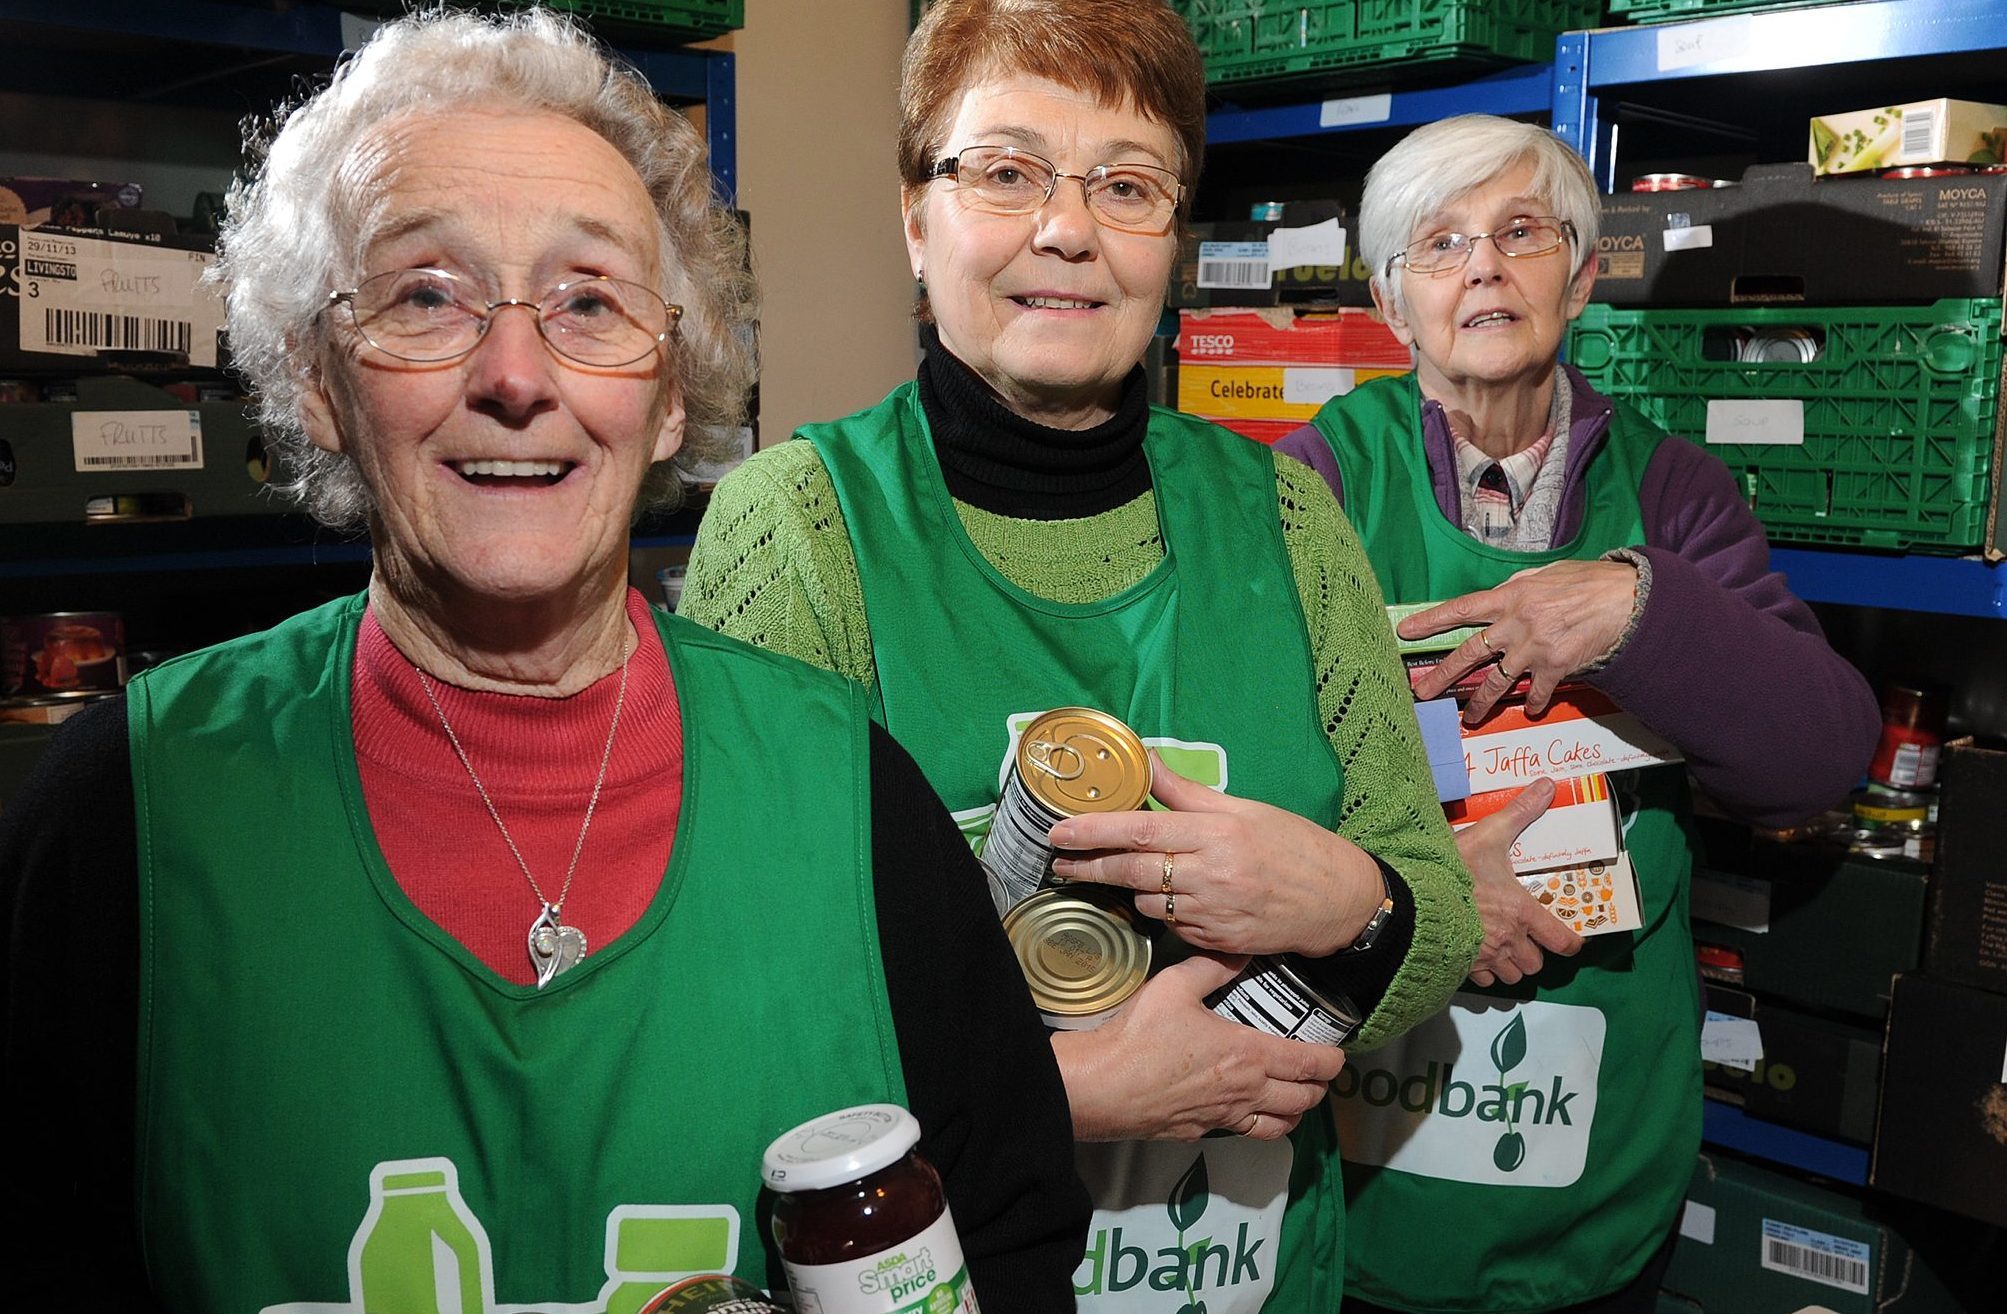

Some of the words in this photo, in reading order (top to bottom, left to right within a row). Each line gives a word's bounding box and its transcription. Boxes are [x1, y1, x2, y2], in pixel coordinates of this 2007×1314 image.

[1939, 188, 1987, 200] MOYCA
[28, 242, 76, 255] 29/11/13
[1599, 235, 1644, 252] OYCA
[28, 282, 40, 299] 3
[1190, 335, 1234, 348] TESCO
[1483, 745, 1540, 777] Jaffa
[1547, 738, 1601, 766] Cakes
[1331, 1062, 1579, 1126] oodbank
[877, 1253, 908, 1272] ASDA
[1074, 1222, 1265, 1296] dbank
[859, 1246, 935, 1295] Smart
[890, 1269, 937, 1304] price
